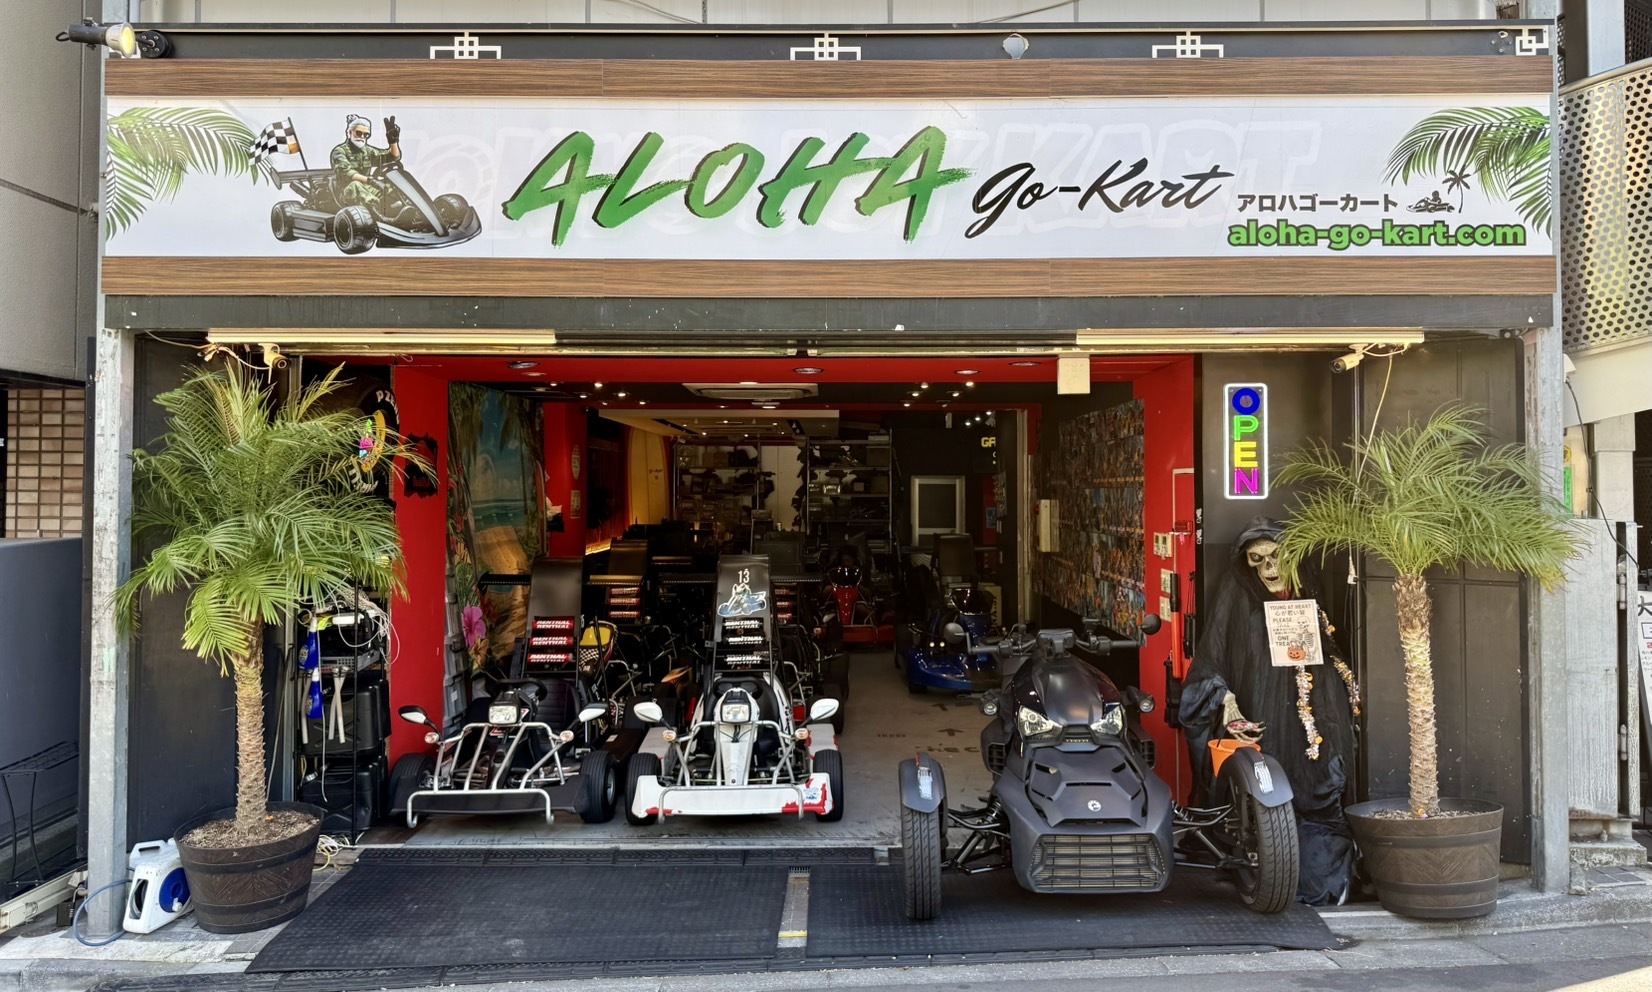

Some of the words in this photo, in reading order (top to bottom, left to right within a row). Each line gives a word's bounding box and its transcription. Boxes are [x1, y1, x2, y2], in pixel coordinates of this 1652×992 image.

[502, 126, 977, 248] ALOHA
[1237, 193, 1398, 212] アロハゴーカート
[1227, 218, 1526, 251] aloha-go-kart.com
[1232, 387, 1261, 494] OPEN
